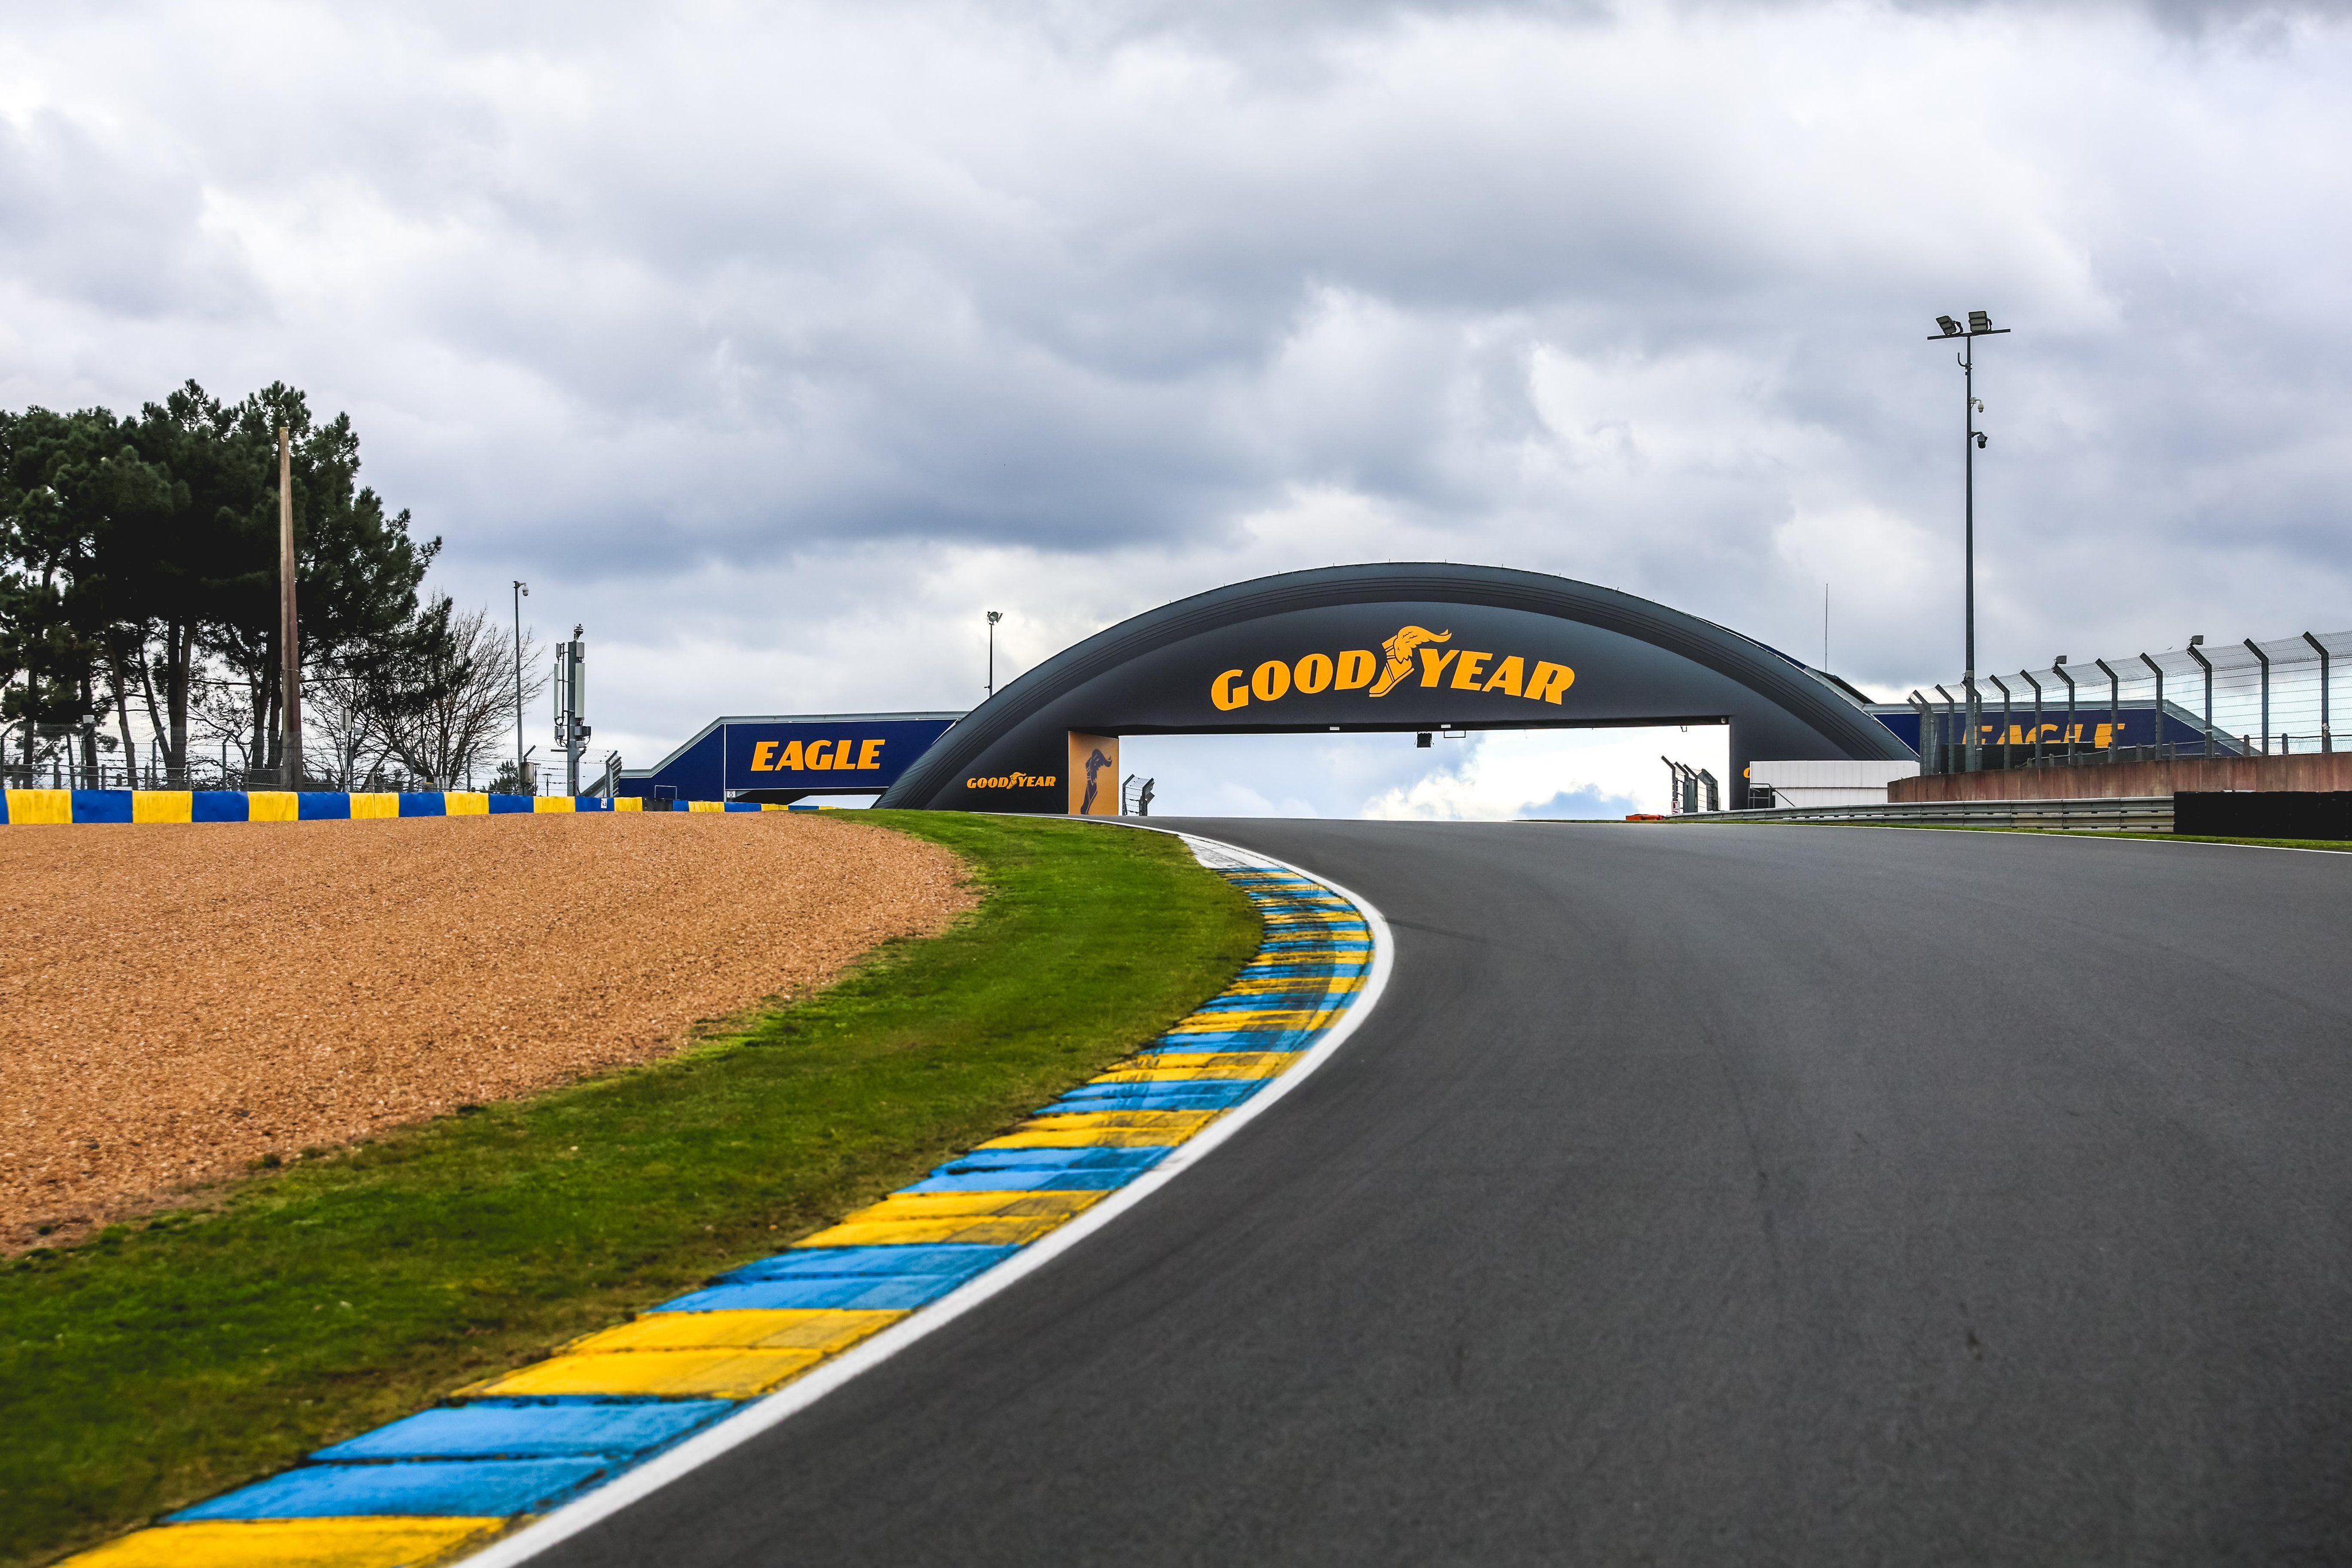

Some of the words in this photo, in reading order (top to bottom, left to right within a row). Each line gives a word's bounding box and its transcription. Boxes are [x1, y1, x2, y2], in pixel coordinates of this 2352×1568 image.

[1210, 648, 1575, 711] GOODYEAR
[751, 739, 885, 771] EAGLE
[966, 776, 1057, 789] GOODYEAR
